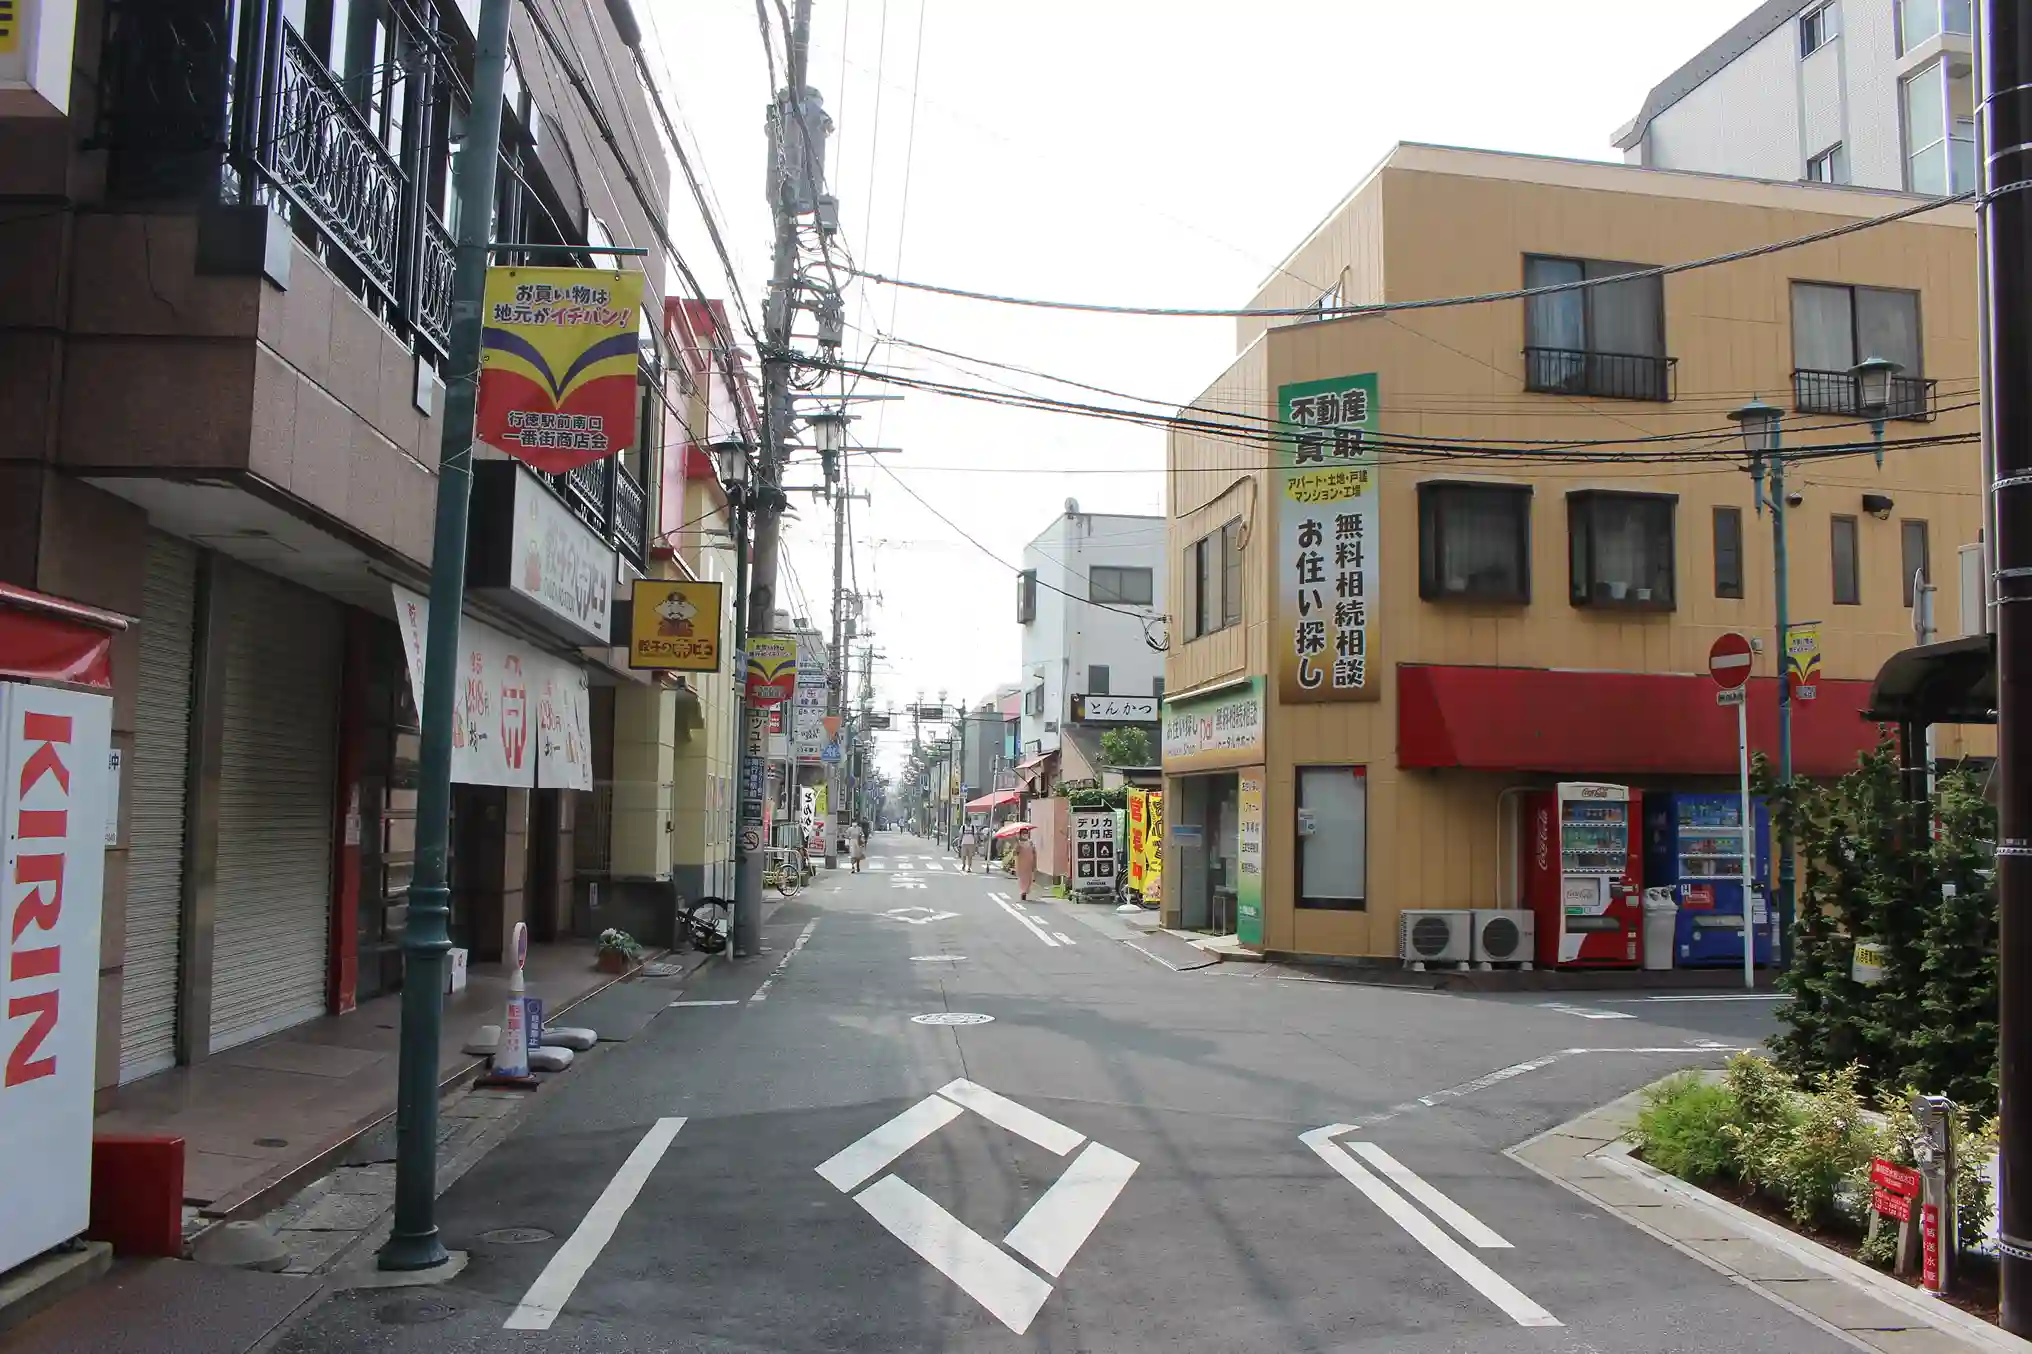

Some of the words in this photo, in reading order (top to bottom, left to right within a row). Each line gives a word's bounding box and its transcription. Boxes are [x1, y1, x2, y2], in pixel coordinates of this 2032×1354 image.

[516, 285, 610, 304] お買い物は
[494, 304, 632, 327] 地元がイチバン!
[1290, 389, 1367, 428] 不動産
[508, 411, 603, 431] 行徳駅前南口
[502, 430, 608, 449] 一番街商店会
[1296, 518, 1326, 689] お住い探し
[1333, 513, 1364, 688] 無料相続相談
[1091, 701, 1152, 716] とんかつ
[1078, 818, 1113, 828] デリカ
[1078, 829, 1113, 839] 専門店
[1538, 808, 1549, 871] Coca-Cola
[5, 710, 73, 1088] KIRIN
